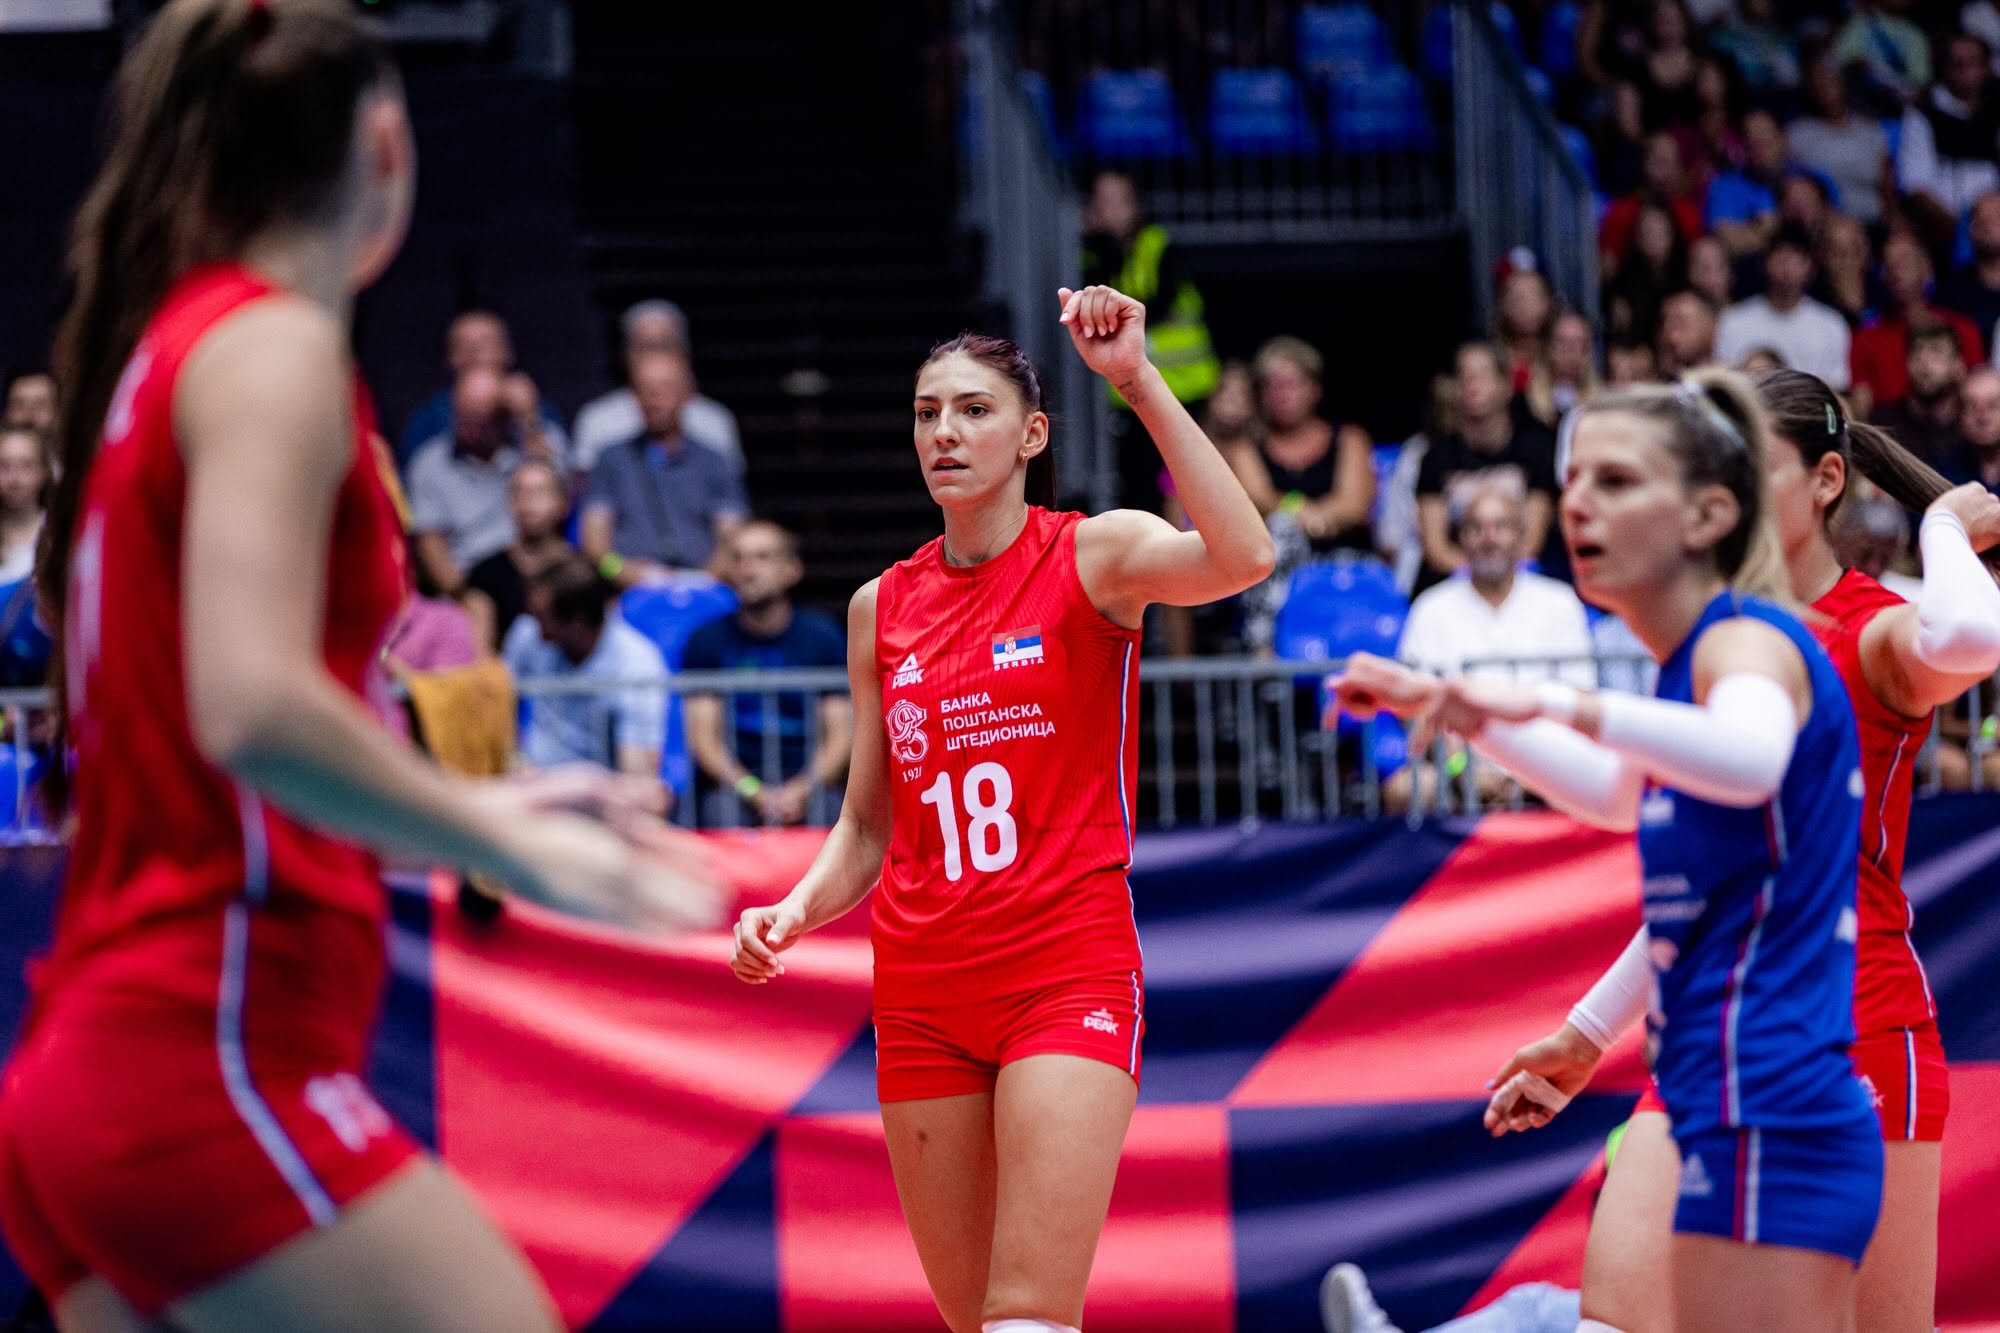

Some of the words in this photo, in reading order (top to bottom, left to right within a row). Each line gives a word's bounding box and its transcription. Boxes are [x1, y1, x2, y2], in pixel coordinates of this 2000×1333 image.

[994, 657, 1045, 671] SERBIA
[892, 668, 925, 690] PEAK
[941, 692, 992, 713] БАНКА
[943, 703, 1043, 732] ПОШТАНСКА
[946, 721, 1056, 751] ШТЕДИОНИЦА
[921, 762, 1018, 881] 18
[1083, 1015, 1119, 1036] PEAK
